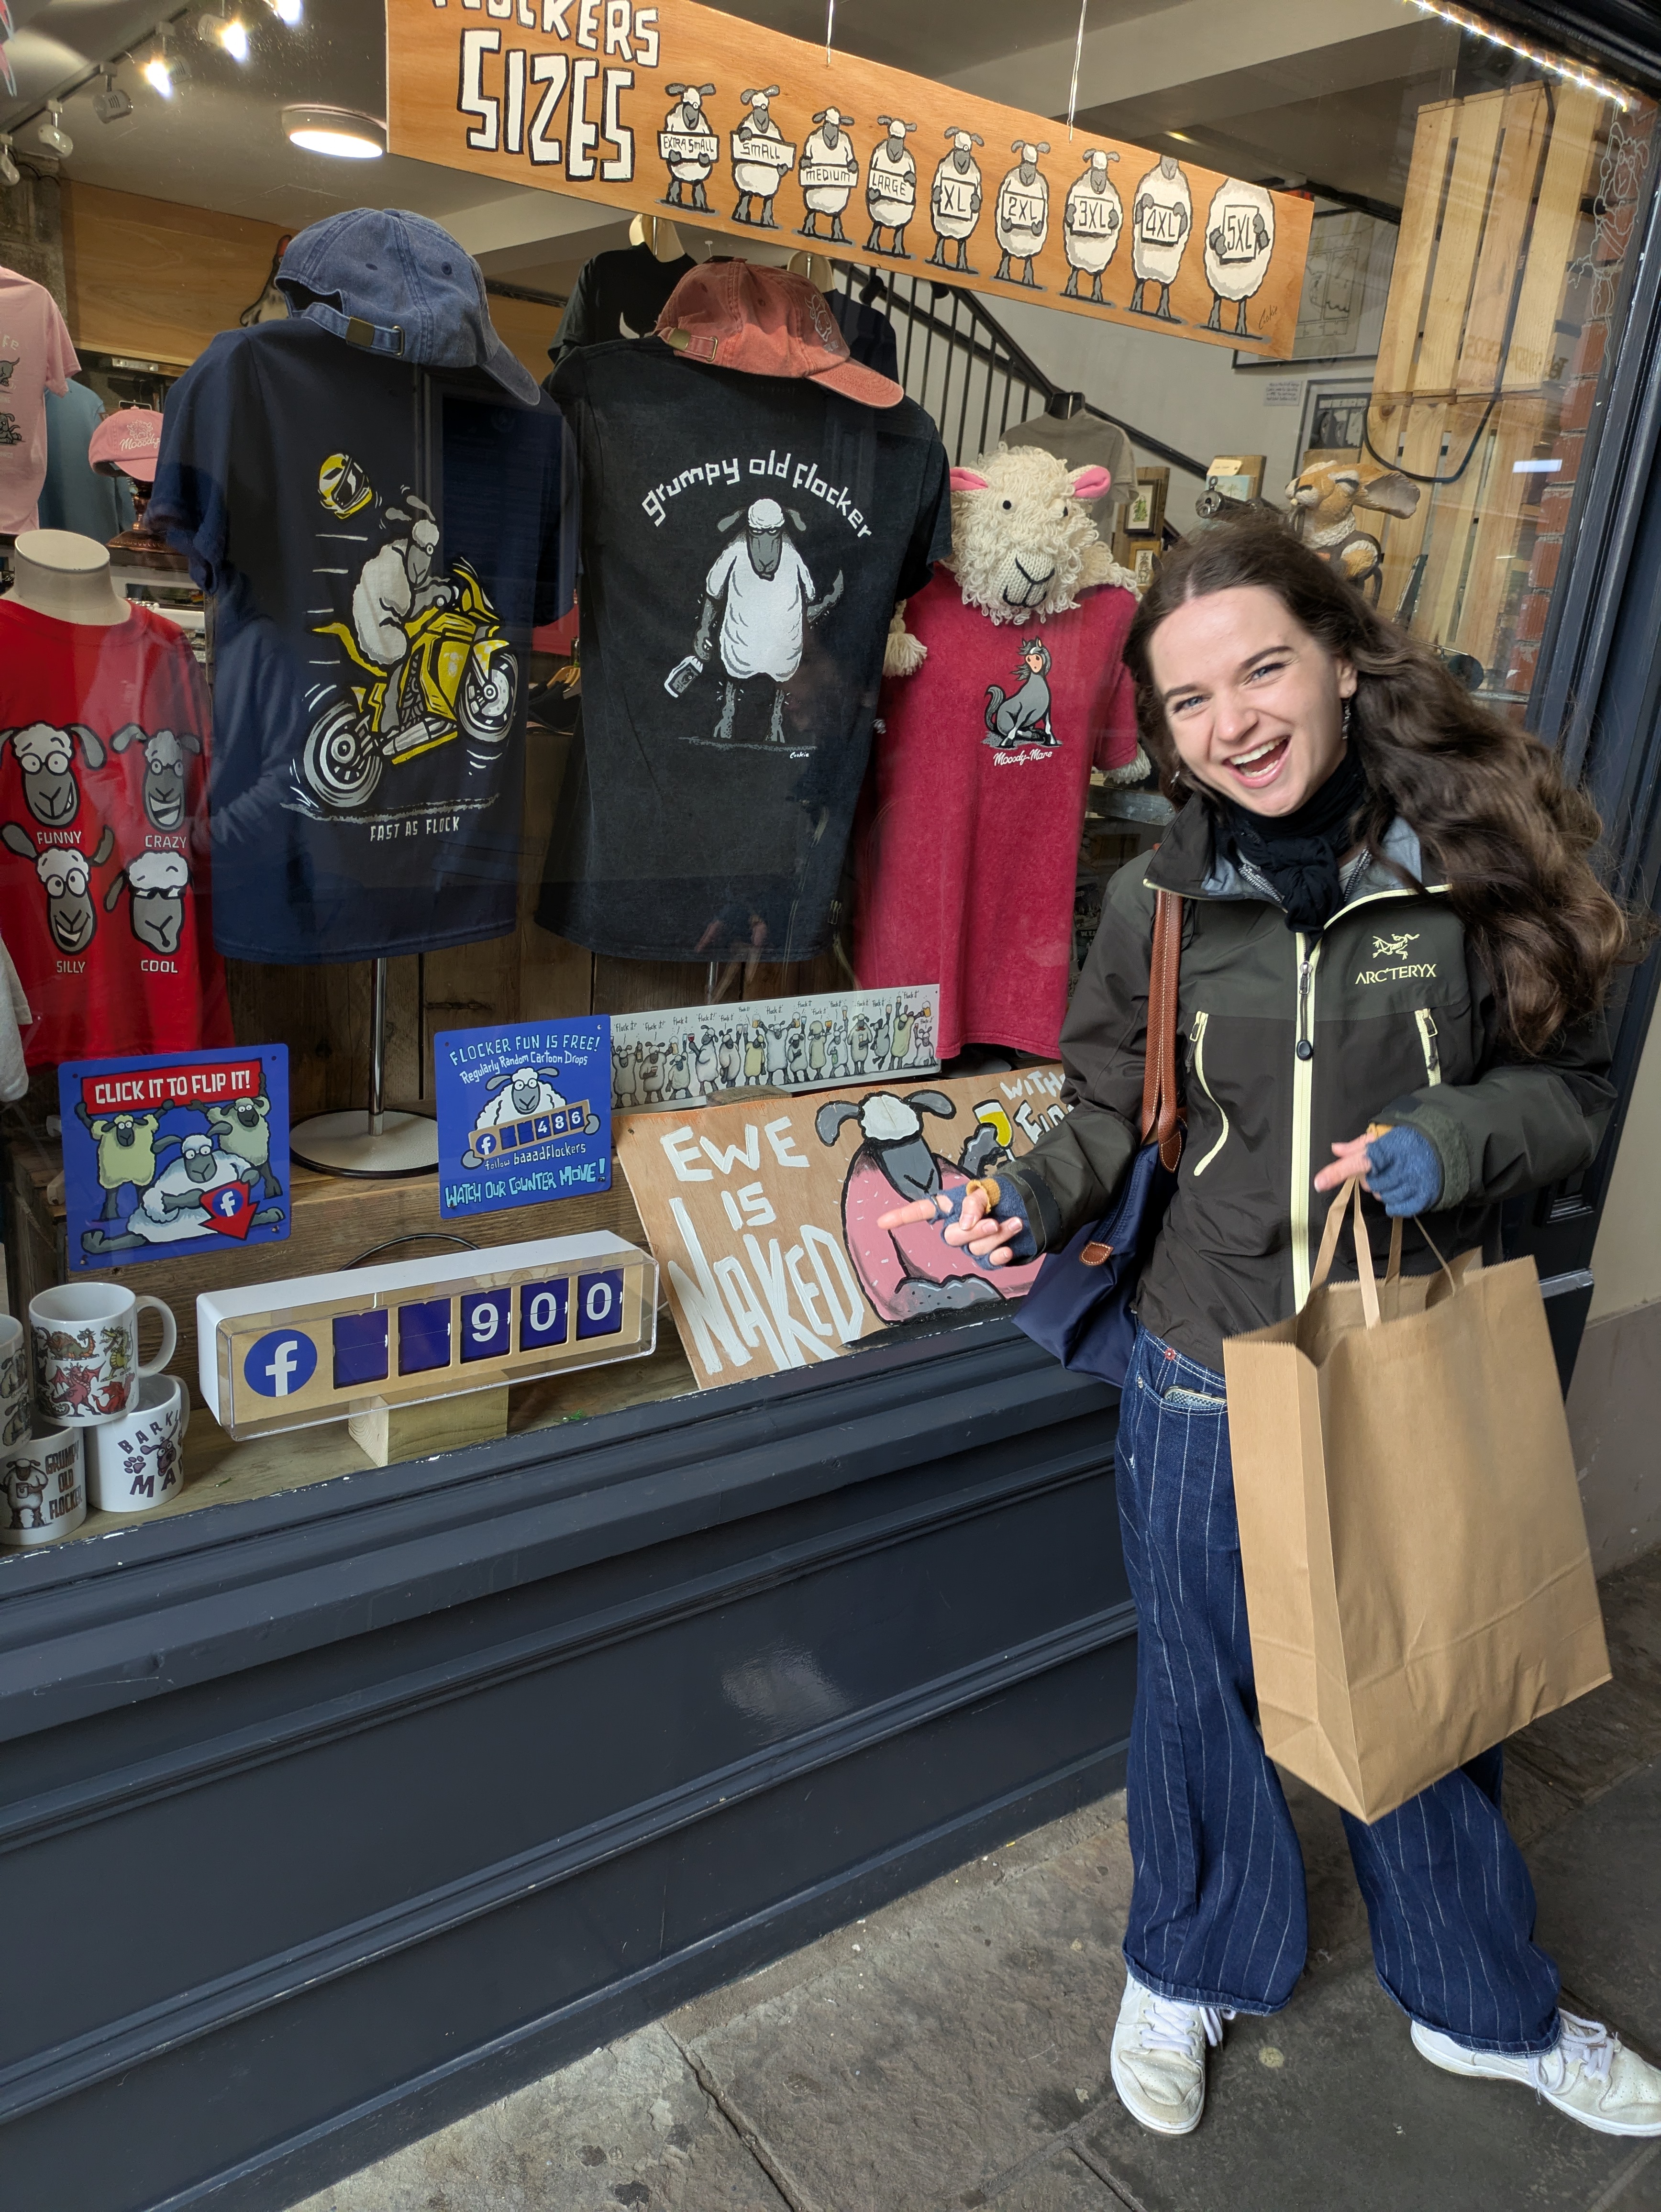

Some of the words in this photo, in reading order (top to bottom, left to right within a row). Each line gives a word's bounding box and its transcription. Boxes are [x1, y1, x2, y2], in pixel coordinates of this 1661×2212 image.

[457, 28, 635, 182] SIZES
[664, 136, 686, 151] EXTRA
[872, 173, 907, 196] LARGE
[944, 185, 966, 212] XL
[1008, 200, 1037, 220] 2XL
[1079, 200, 1107, 228] 3XL
[1145, 215, 1176, 239] 4XL
[1227, 215, 1252, 251] 5XL
[642, 458, 740, 527] grumpy
[749, 450, 791, 478] old
[792, 463, 872, 538] flocker
[1030, 748, 1052, 761] Mare
[37, 831, 82, 845] FUNNY
[145, 835, 187, 849] CRAZY
[370, 823, 399, 842] FAST
[405, 820, 418, 836] AS
[426, 816, 460, 834] FLOCK
[56, 960, 86, 974] SILLY
[141, 959, 178, 973] COOL
[449, 1037, 511, 1066] FLOCKER
[516, 1035, 540, 1051] FUN
[546, 1035, 558, 1048] IS
[563, 1034, 601, 1052] FREE!
[459, 1059, 500, 1084] Regularly
[498, 1054, 529, 1068] Random
[564, 1050, 589, 1066] Drops
[95, 1080, 145, 1104] CLICK
[149, 1078, 163, 1098] IT
[166, 1076, 188, 1096] TO
[191, 1073, 226, 1094] FLIP
[231, 1070, 251, 1090] IT!
[660, 1116, 810, 1182] EWE
[485, 1158, 510, 1171] follow
[444, 1182, 481, 1207] WATCH
[485, 1180, 507, 1198] OUR
[720, 1181, 777, 1231] IS
[667, 1197, 864, 1375] NAKED
[58, 1468, 74, 1493] OLD
